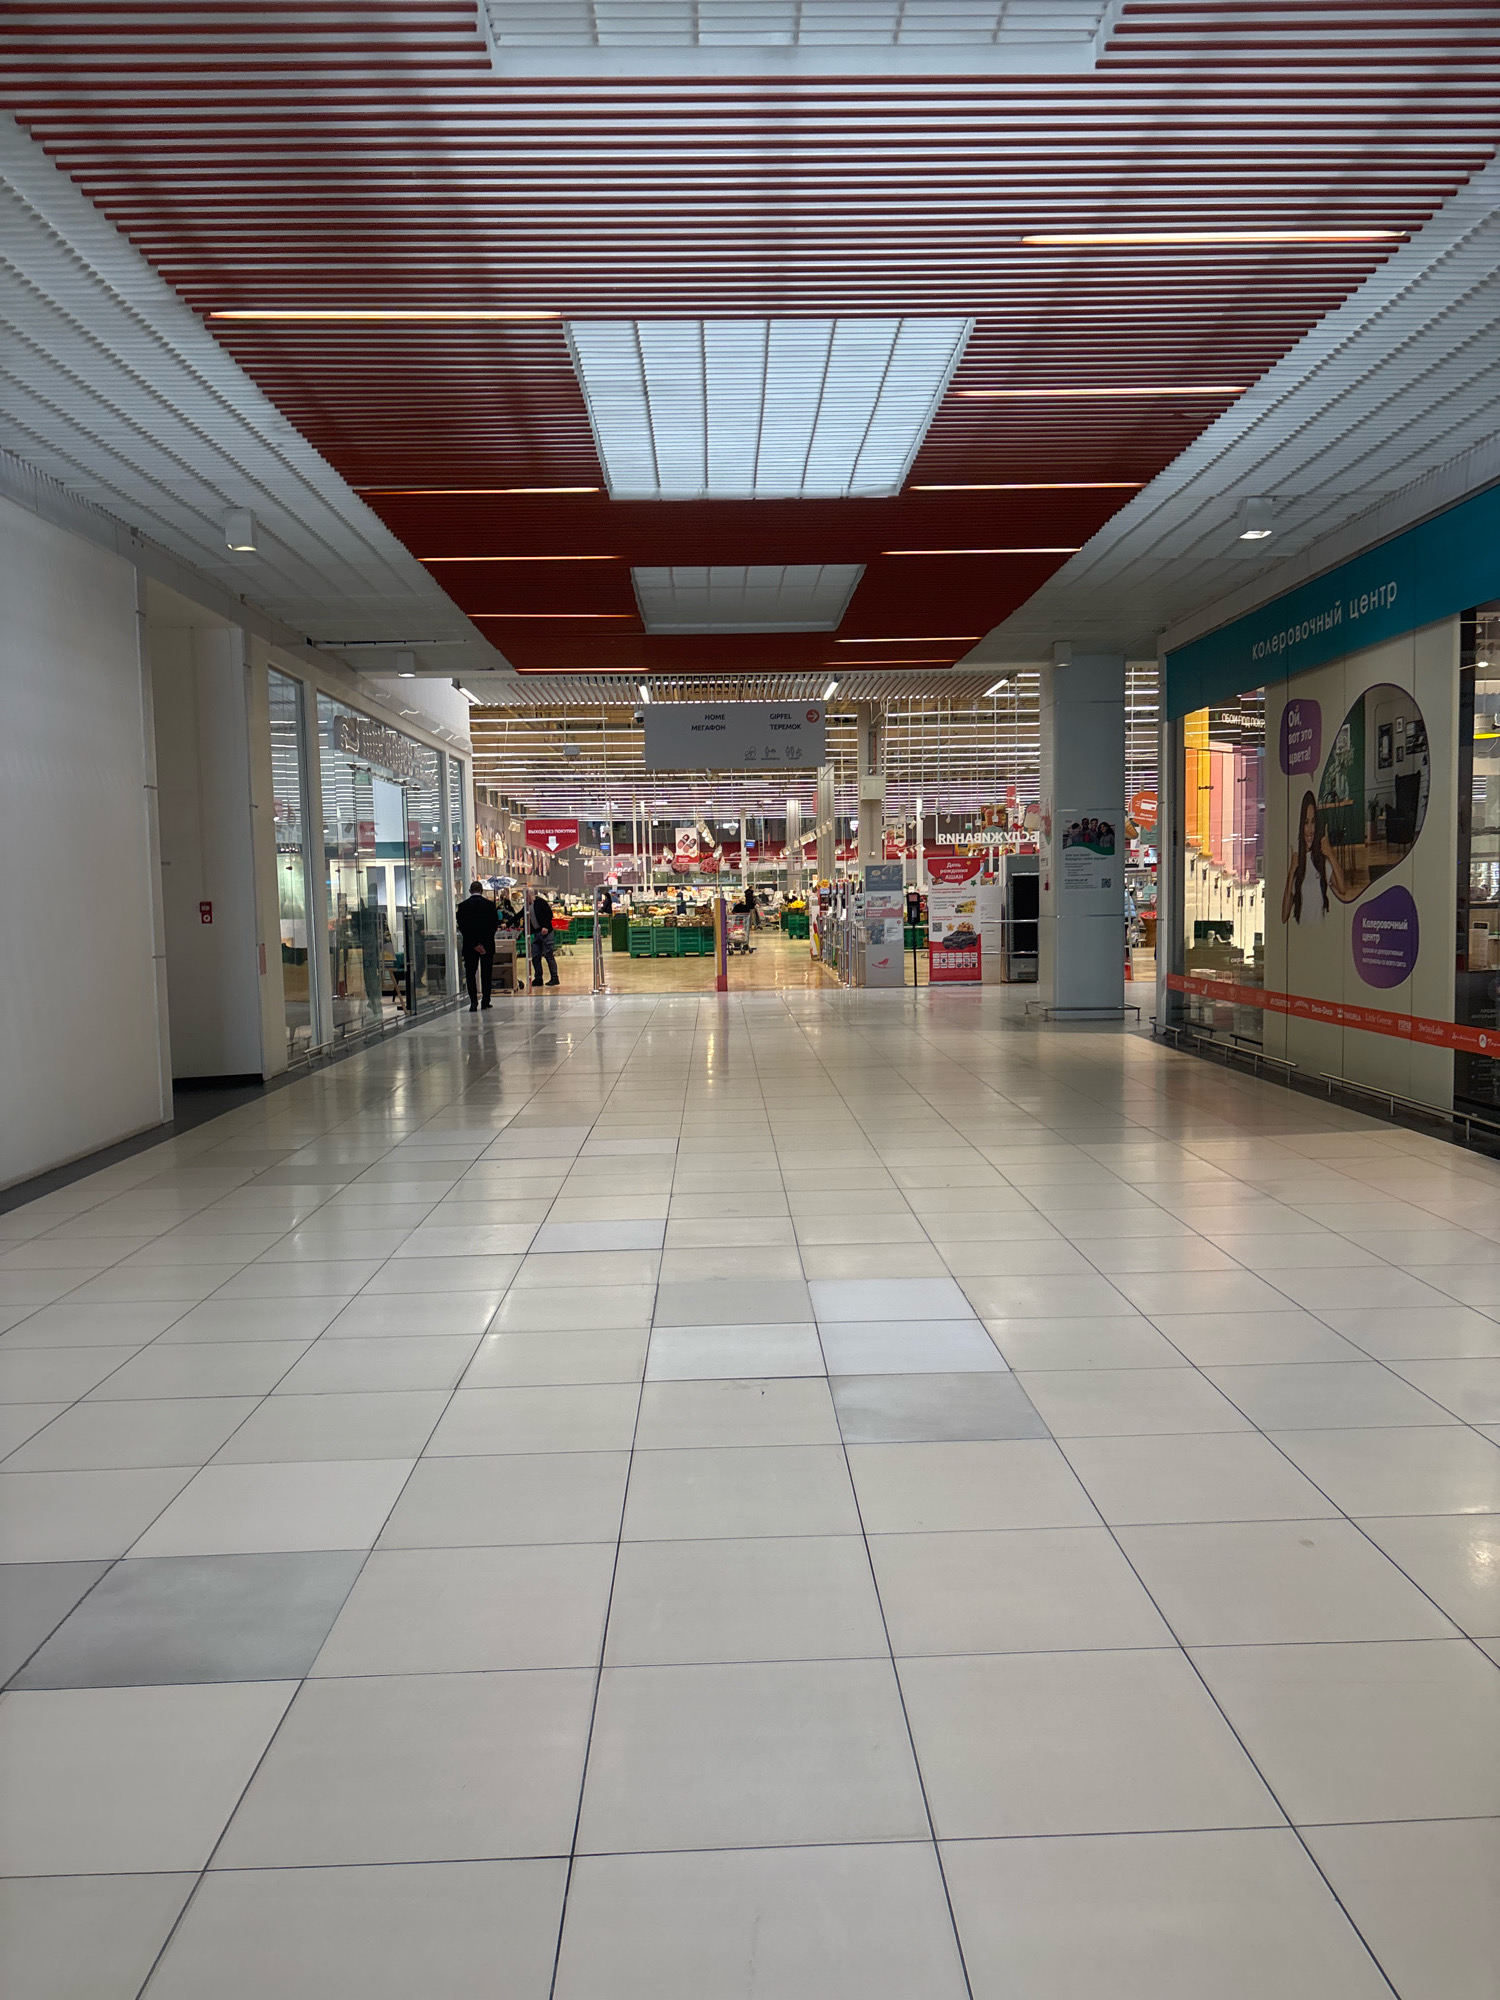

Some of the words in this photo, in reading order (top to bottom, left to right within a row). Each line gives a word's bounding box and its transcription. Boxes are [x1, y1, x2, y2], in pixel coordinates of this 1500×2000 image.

[1252, 600, 1342, 660] колеровочный
[1349, 581, 1398, 619] центр
[1288, 732, 1300, 745] вот
[1300, 728, 1313, 743] это
[1288, 746, 1312, 766] цвета!
[1362, 917, 1408, 931] Колеровочный
[1362, 933, 1380, 945] центр
